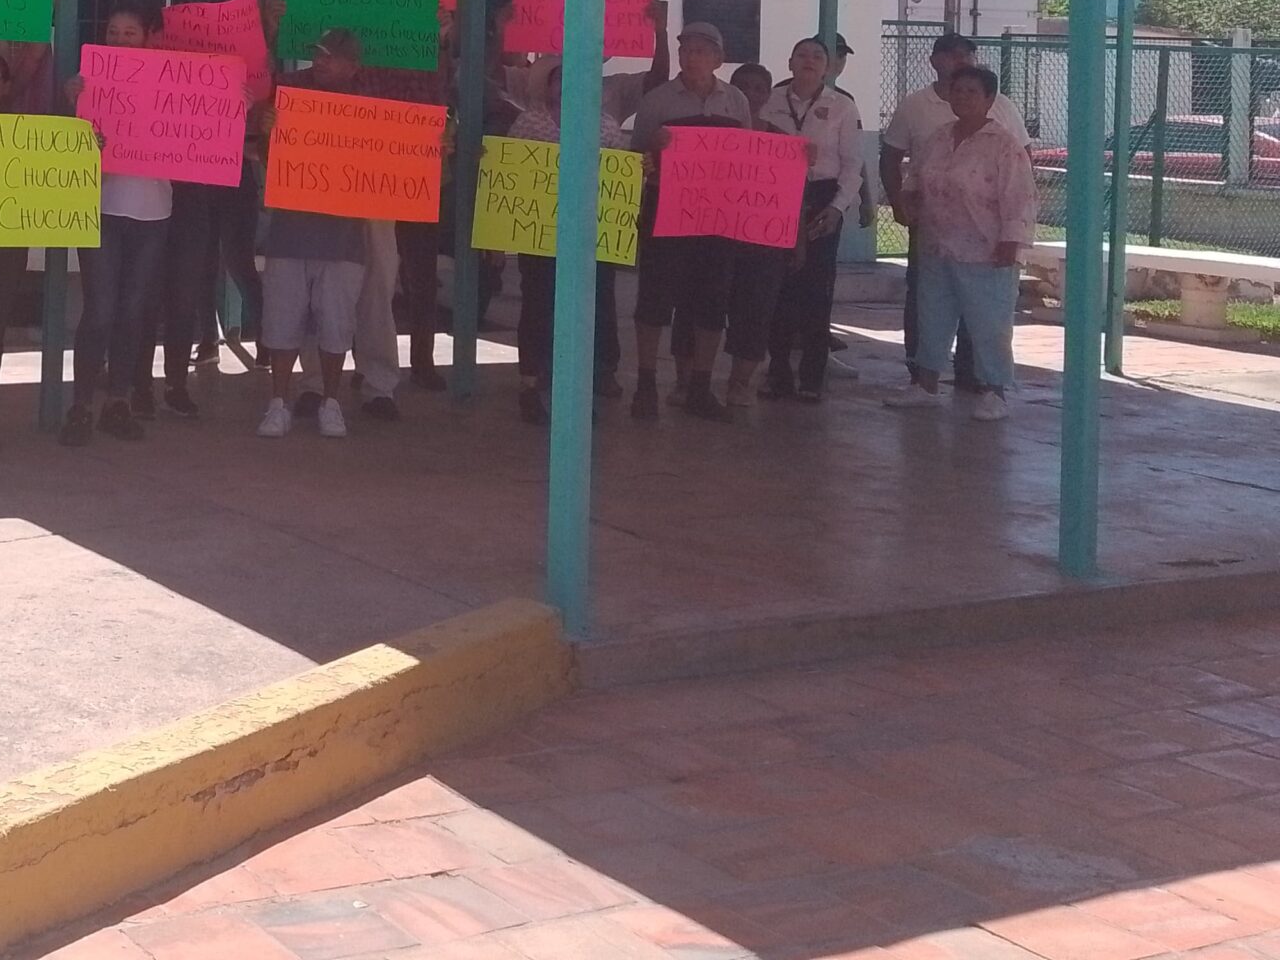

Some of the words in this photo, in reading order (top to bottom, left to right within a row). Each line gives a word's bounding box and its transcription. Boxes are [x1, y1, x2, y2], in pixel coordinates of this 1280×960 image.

[91, 51, 145, 84] DIEZ
[91, 86, 136, 116] IMSS
[153, 90, 247, 123] TAMAZULA
[277, 90, 377, 120] DESTITUCION
[404, 108, 445, 128] CARGO
[12, 115, 98, 154] CHUCUAN
[115, 119, 139, 138] EL
[275, 127, 298, 146] ING
[304, 129, 384, 153] GUILLERMO
[389, 140, 442, 158] CHUCUAN
[112, 143, 183, 164] GUILLERMO
[499, 142, 636, 178] EXIOS
[672, 131, 798, 161] EXIGIMOS
[4, 156, 98, 189] CHUCUAN
[277, 158, 330, 192] IMSS
[339, 163, 431, 201] SINALOA
[478, 168, 519, 190] MAS
[530, 169, 641, 207] PENAL
[671, 160, 778, 185] ASISTENTES
[486, 192, 540, 220] PARA
[680, 187, 712, 206] POR
[723, 189, 779, 209] CADA
[512, 218, 635, 260] MEA!!
